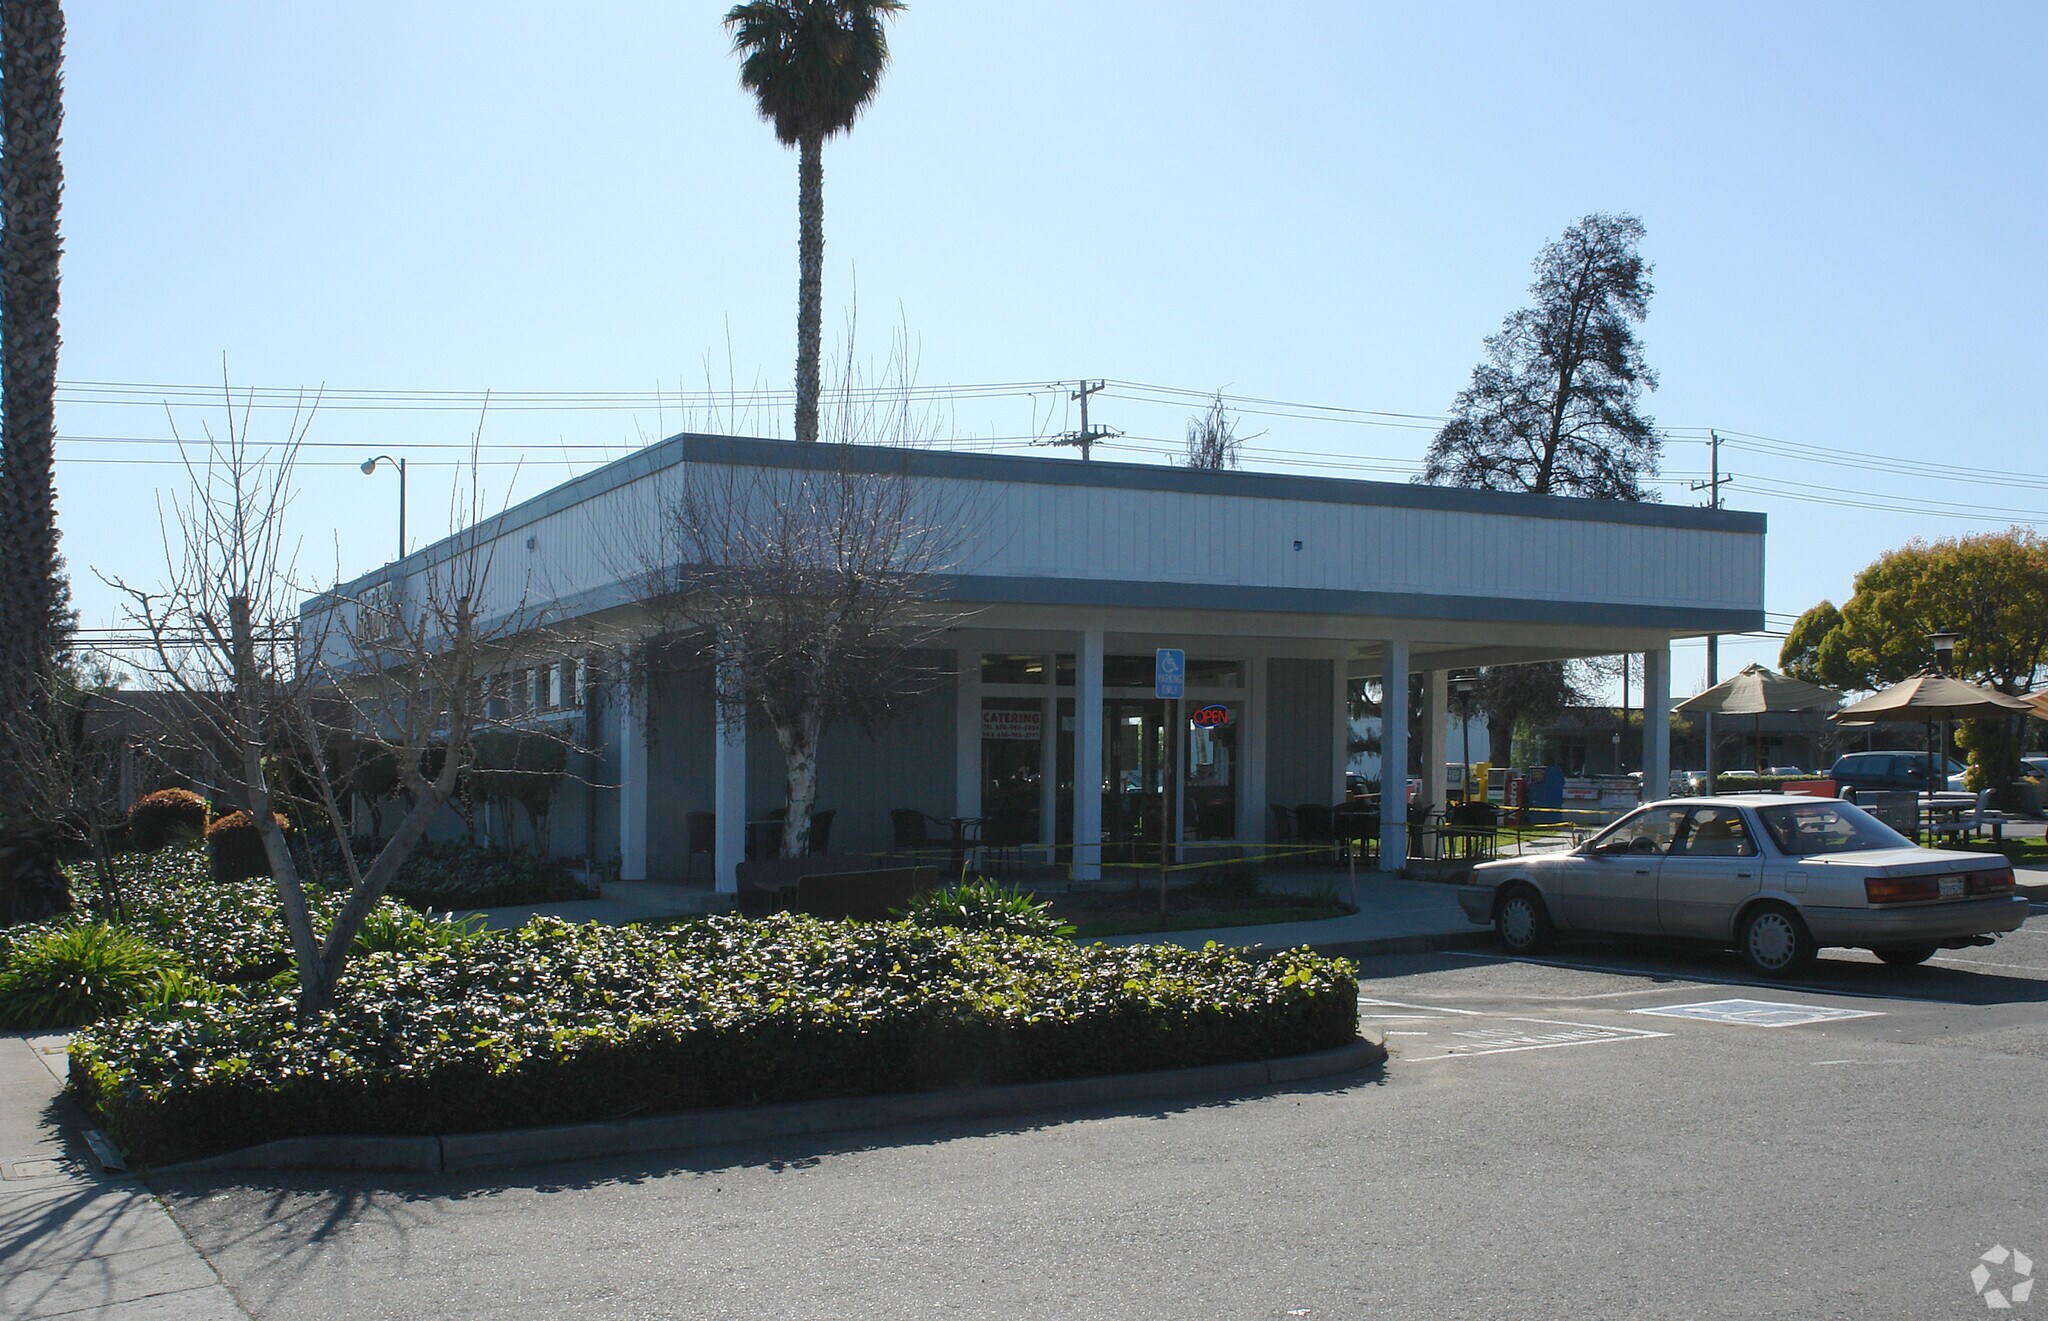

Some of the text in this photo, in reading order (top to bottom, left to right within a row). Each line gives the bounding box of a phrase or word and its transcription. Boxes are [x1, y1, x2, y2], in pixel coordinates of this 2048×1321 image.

[1158, 674, 1183, 683] PARKING
[1162, 685, 1178, 694] ONLY
[983, 712, 1040, 723] CATERING
[1194, 709, 1229, 724] OPEN
